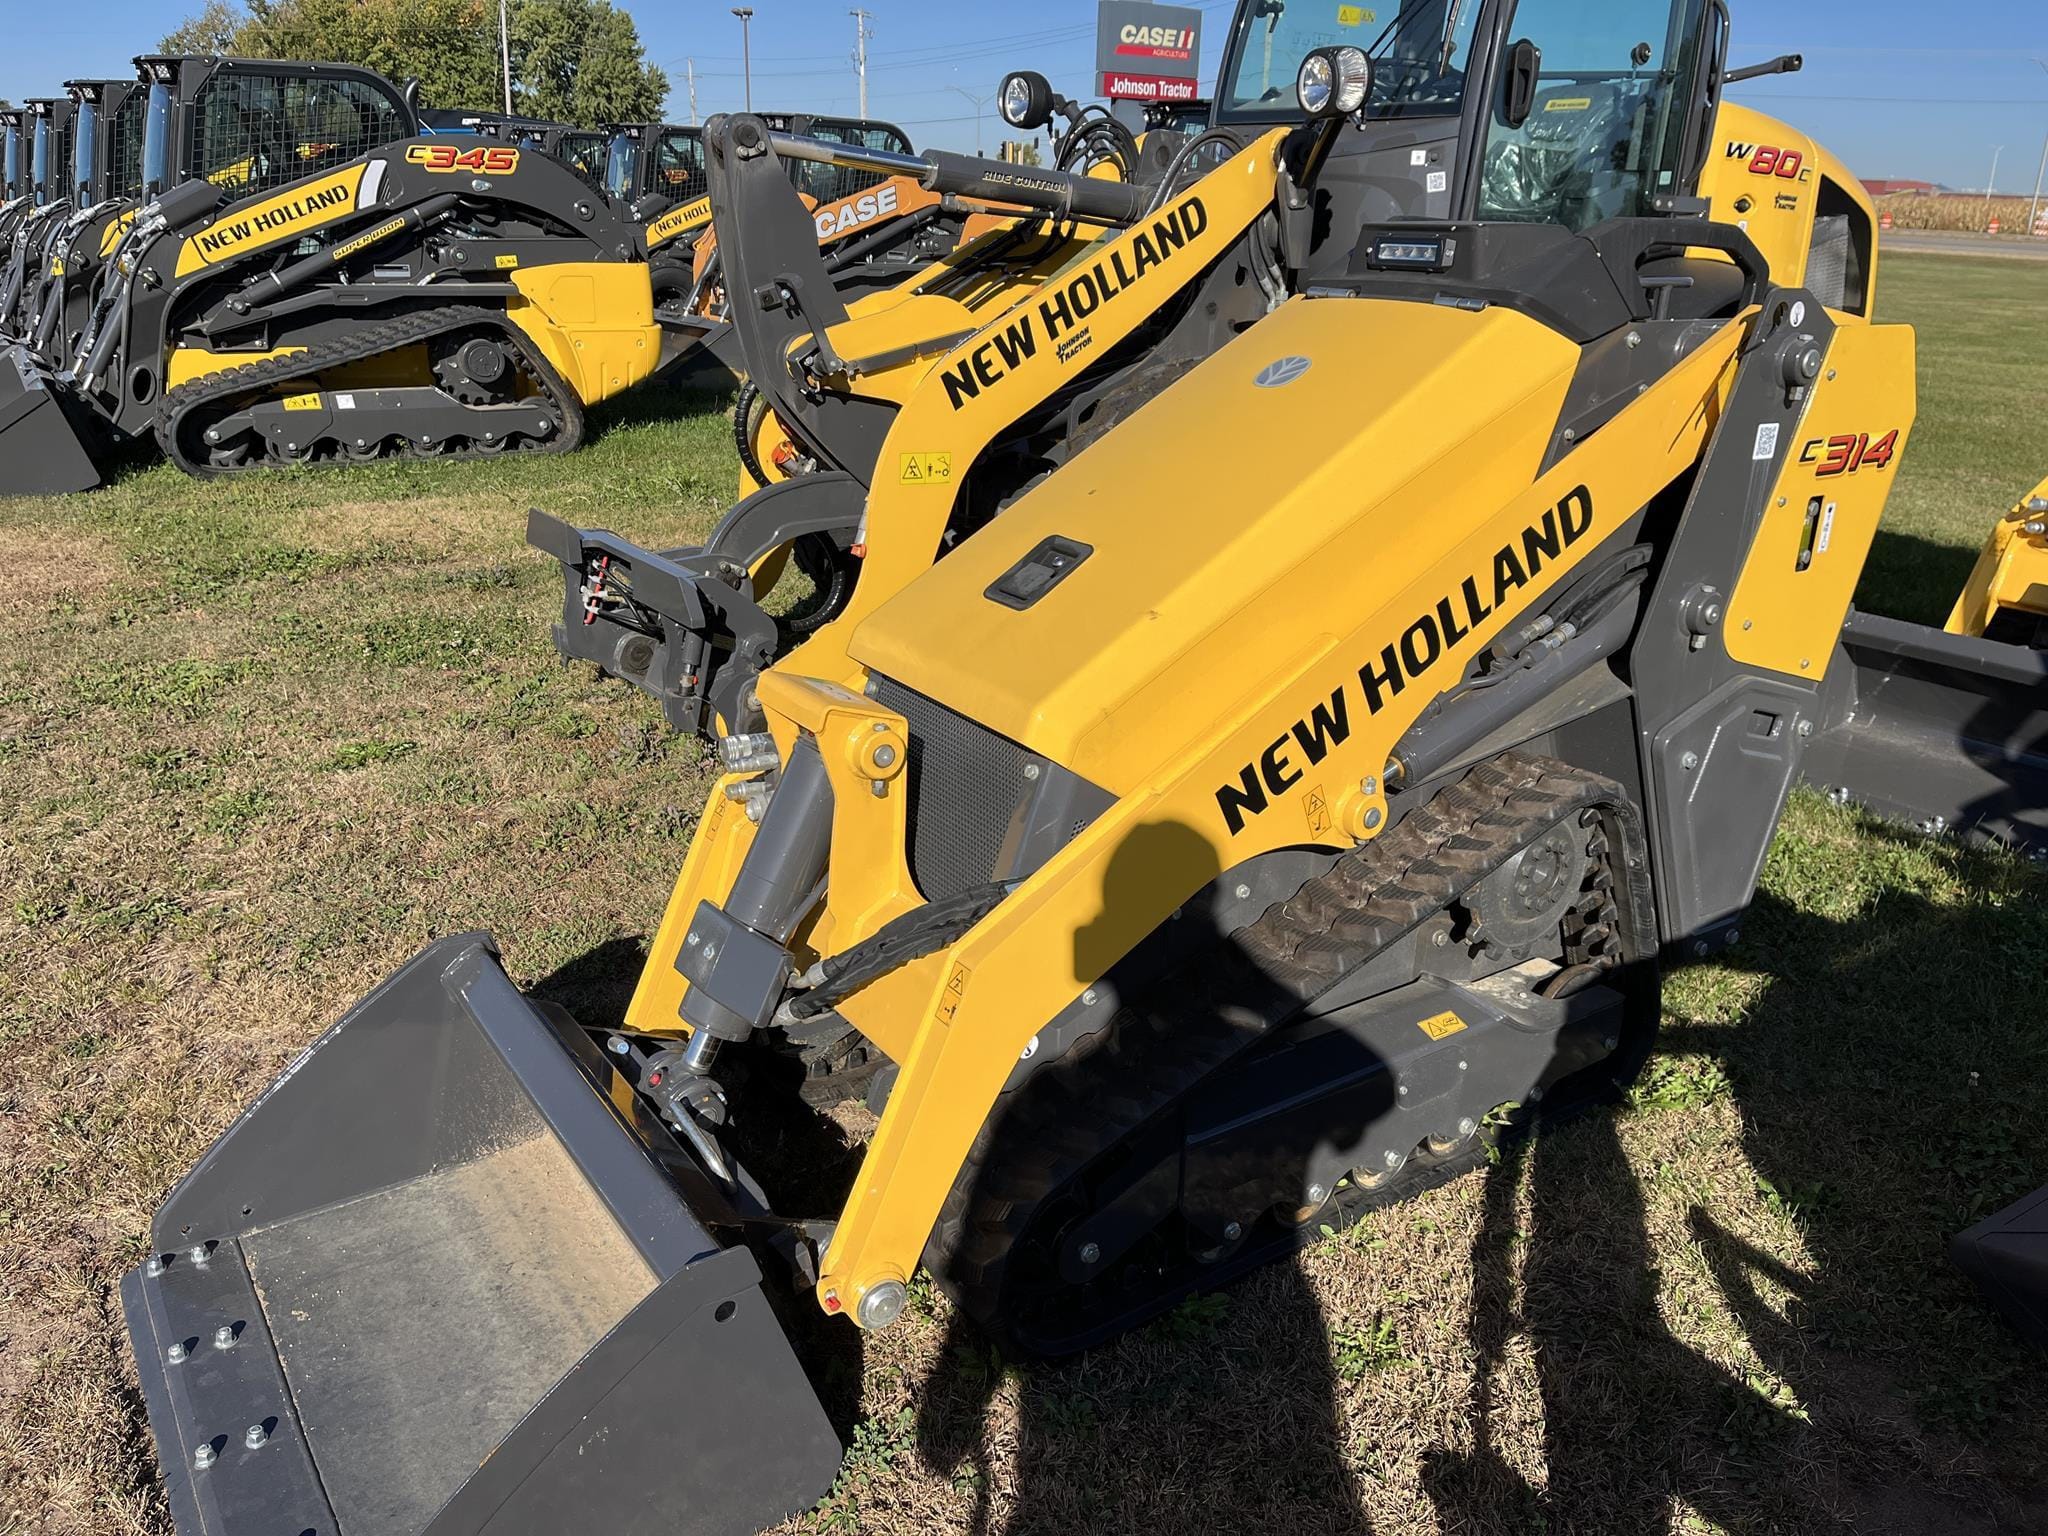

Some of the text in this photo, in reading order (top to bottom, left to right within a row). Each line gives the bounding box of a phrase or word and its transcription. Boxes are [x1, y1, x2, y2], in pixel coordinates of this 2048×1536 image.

[1120, 25, 1178, 47] CASE
[1152, 48, 1189, 59] AGRICULTURE
[1110, 77, 1192, 98] Johnson Tractor
[406, 145, 519, 174] C345
[982, 170, 1068, 194] RIDE CONTROL
[200, 184, 349, 254] NEW HOLLAND
[657, 203, 710, 233] NEW HOLL
[815, 185, 898, 239] CASE
[334, 219, 404, 258] SUPER BOOM
[940, 196, 1209, 412] NEW HOLLAND
[1056, 326, 1090, 356] JOHNSON
[1058, 336, 1093, 365] TRACTOR
[1799, 429, 1899, 476] C314
[1214, 483, 1594, 837] NEW HOLLAND
